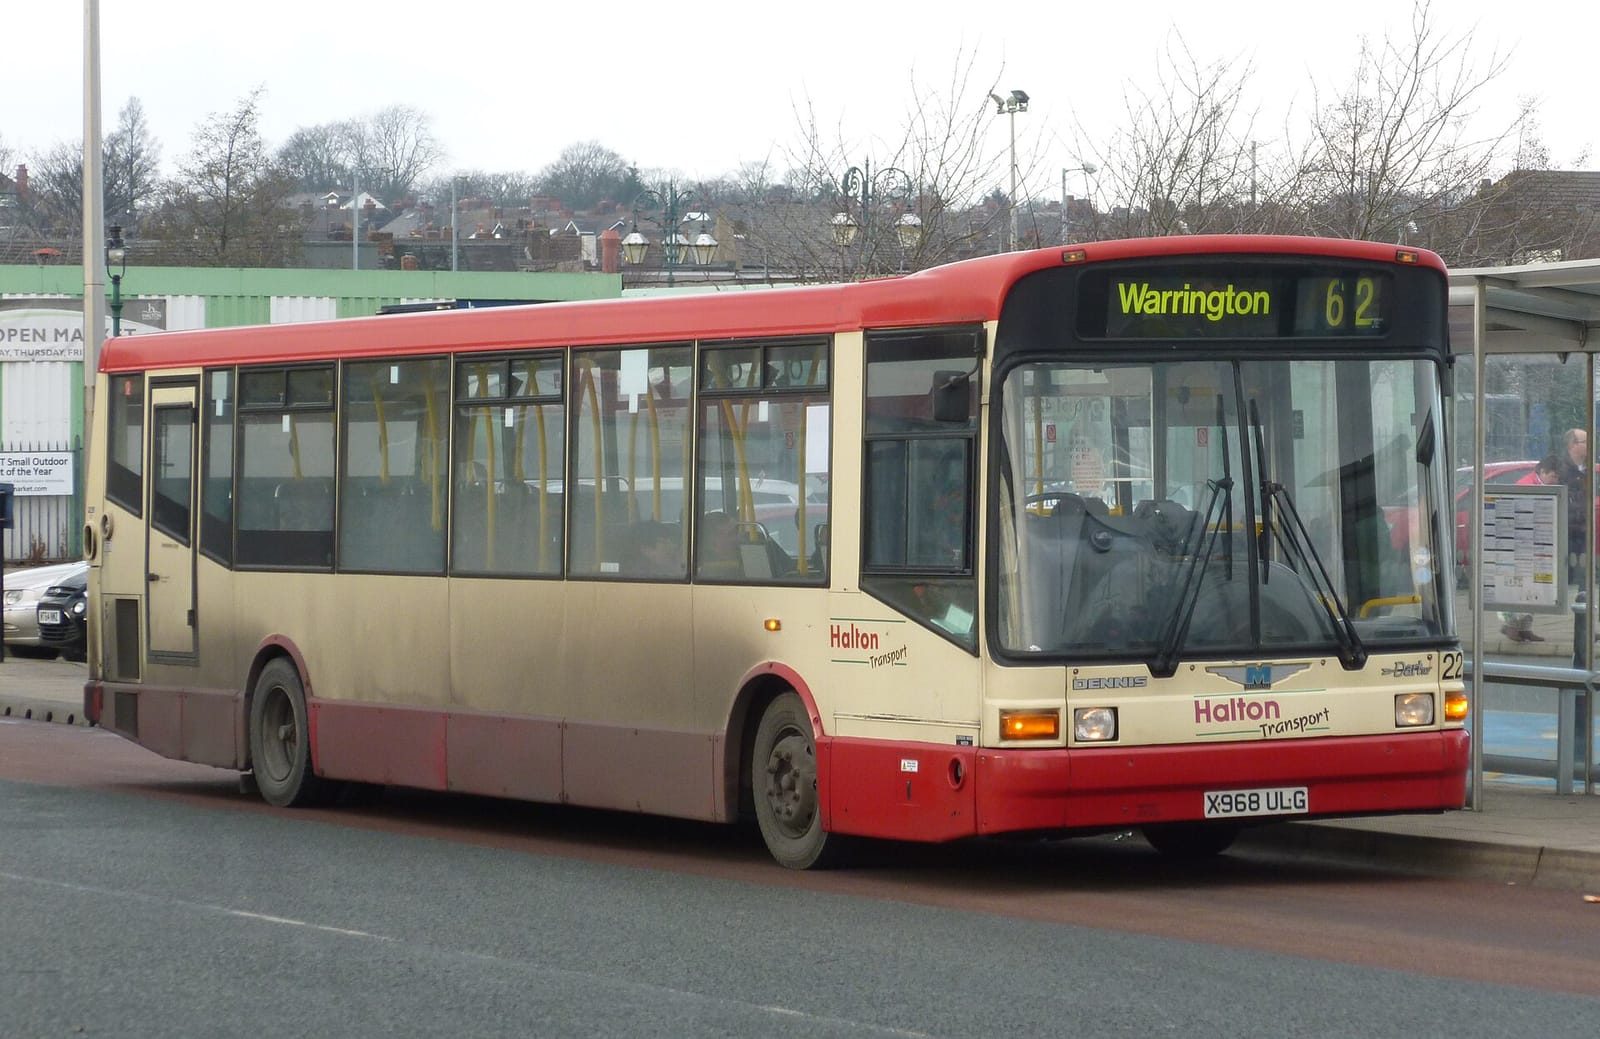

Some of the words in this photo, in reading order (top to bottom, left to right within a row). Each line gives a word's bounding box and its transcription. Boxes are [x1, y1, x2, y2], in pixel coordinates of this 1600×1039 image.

[1118, 283, 1270, 321] Warrington
[6, 467, 16, 476] of
[17, 467, 31, 476] the
[33, 467, 53, 476] Year
[7, 457, 30, 466] Small
[32, 457, 68, 466] Outdoor
[830, 623, 879, 650] Halton
[869, 644, 907, 669] Transport
[1442, 652, 1463, 680] 22
[1073, 676, 1148, 690] DENNIS
[1194, 697, 1281, 724] Halton
[1260, 707, 1329, 738] Transport
[1207, 793, 1260, 814] X968
[1266, 790, 1306, 811] ULG
